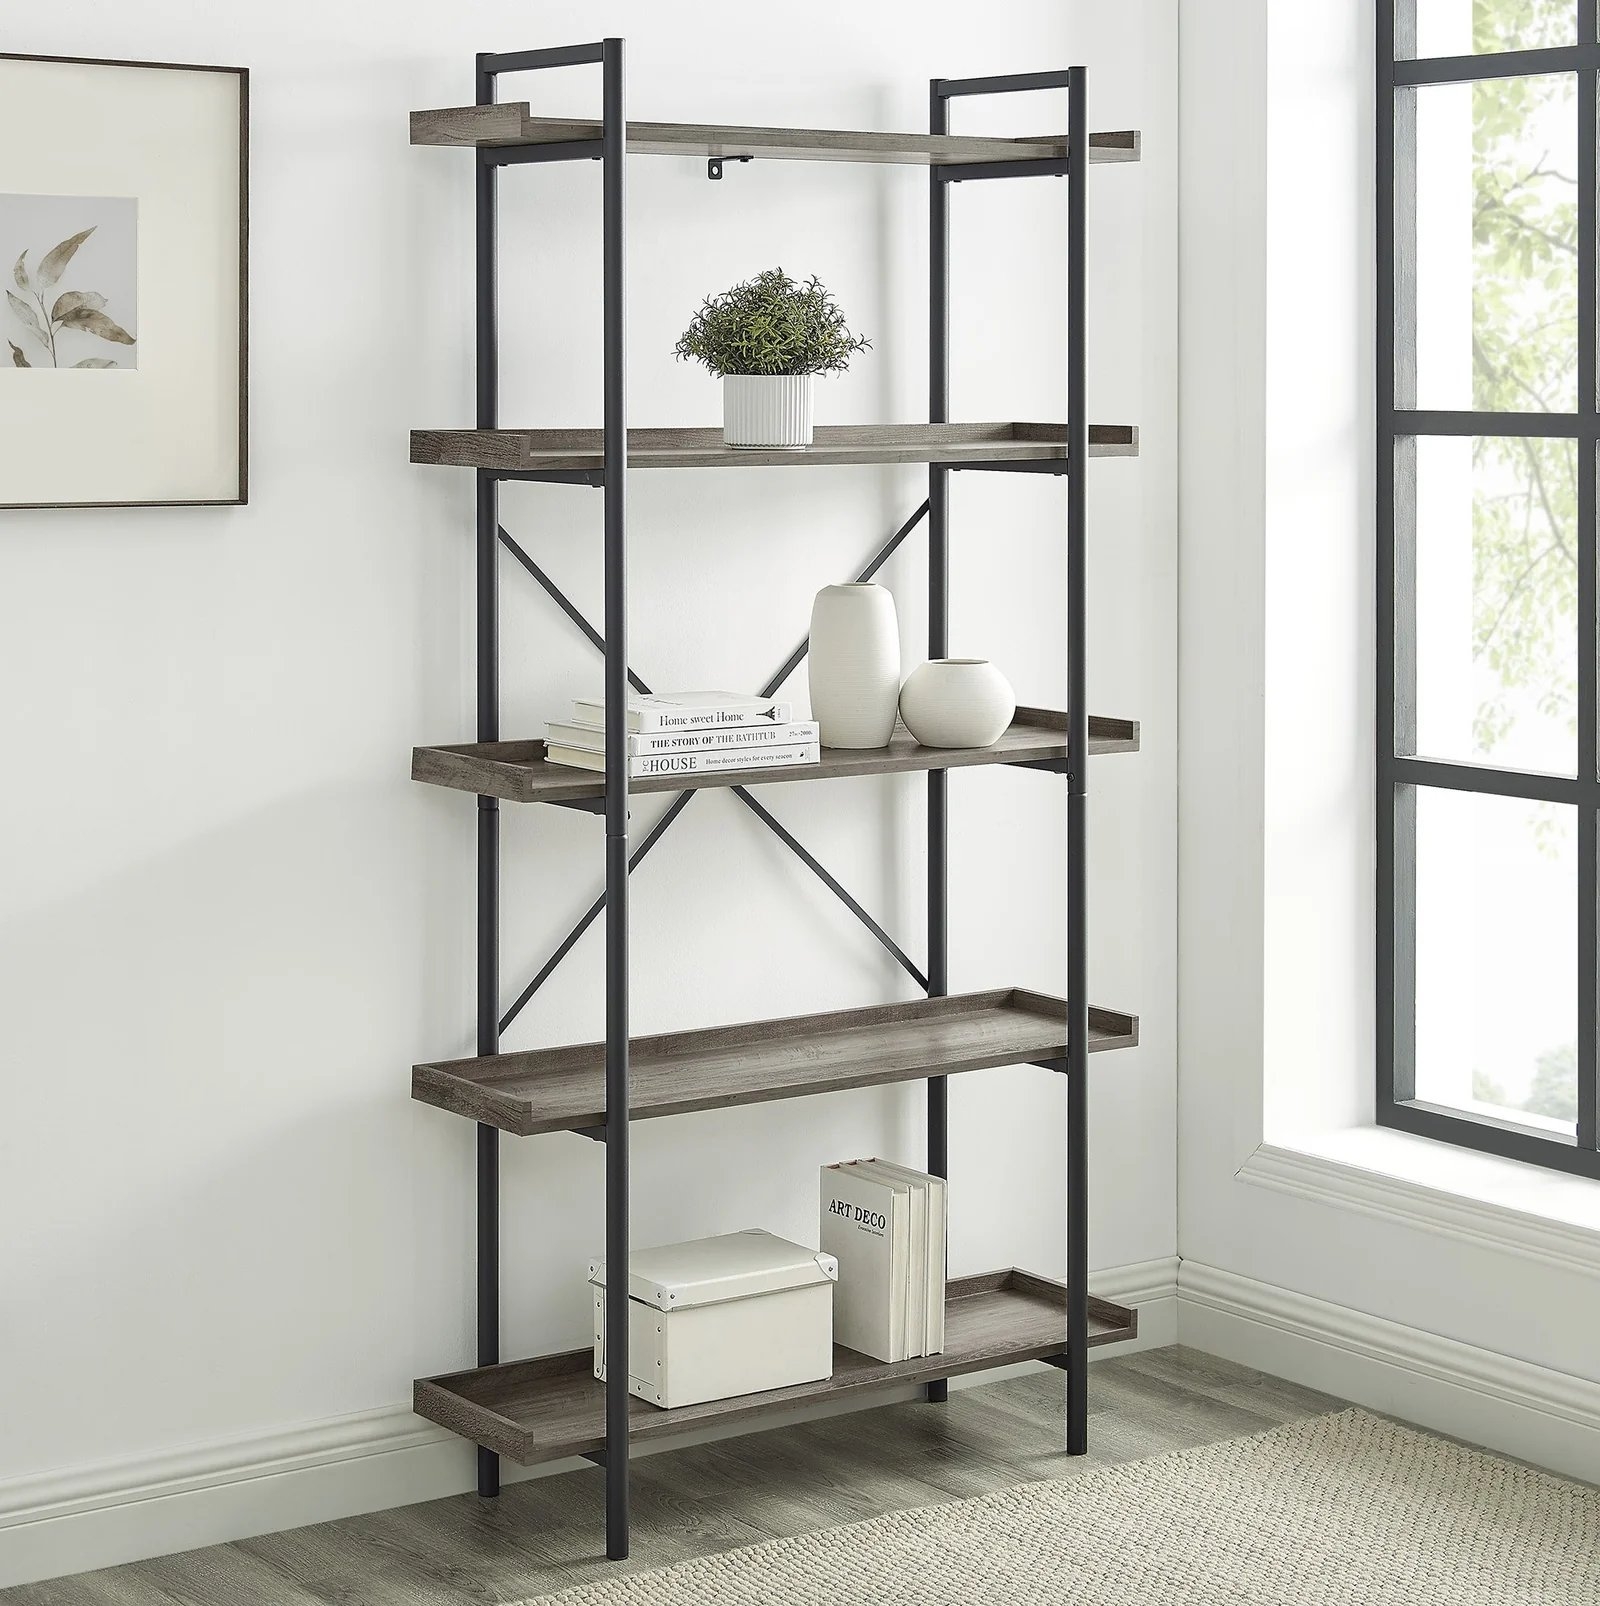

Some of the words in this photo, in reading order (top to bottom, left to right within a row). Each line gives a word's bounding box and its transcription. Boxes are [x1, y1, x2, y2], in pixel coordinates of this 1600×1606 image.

[659, 715, 687, 727] Home
[690, 714, 714, 725] sweet
[716, 711, 745, 723] Home
[650, 739, 670, 749] THE
[671, 737, 700, 747] STORY
[702, 736, 714, 746] OF
[715, 734, 734, 744] THE
[735, 731, 776, 743] BATHTUB
[650, 757, 697, 772] HOUSE
[736, 756, 752, 764] styles
[828, 1199, 852, 1218] ART
[854, 1206, 886, 1230] DECO
